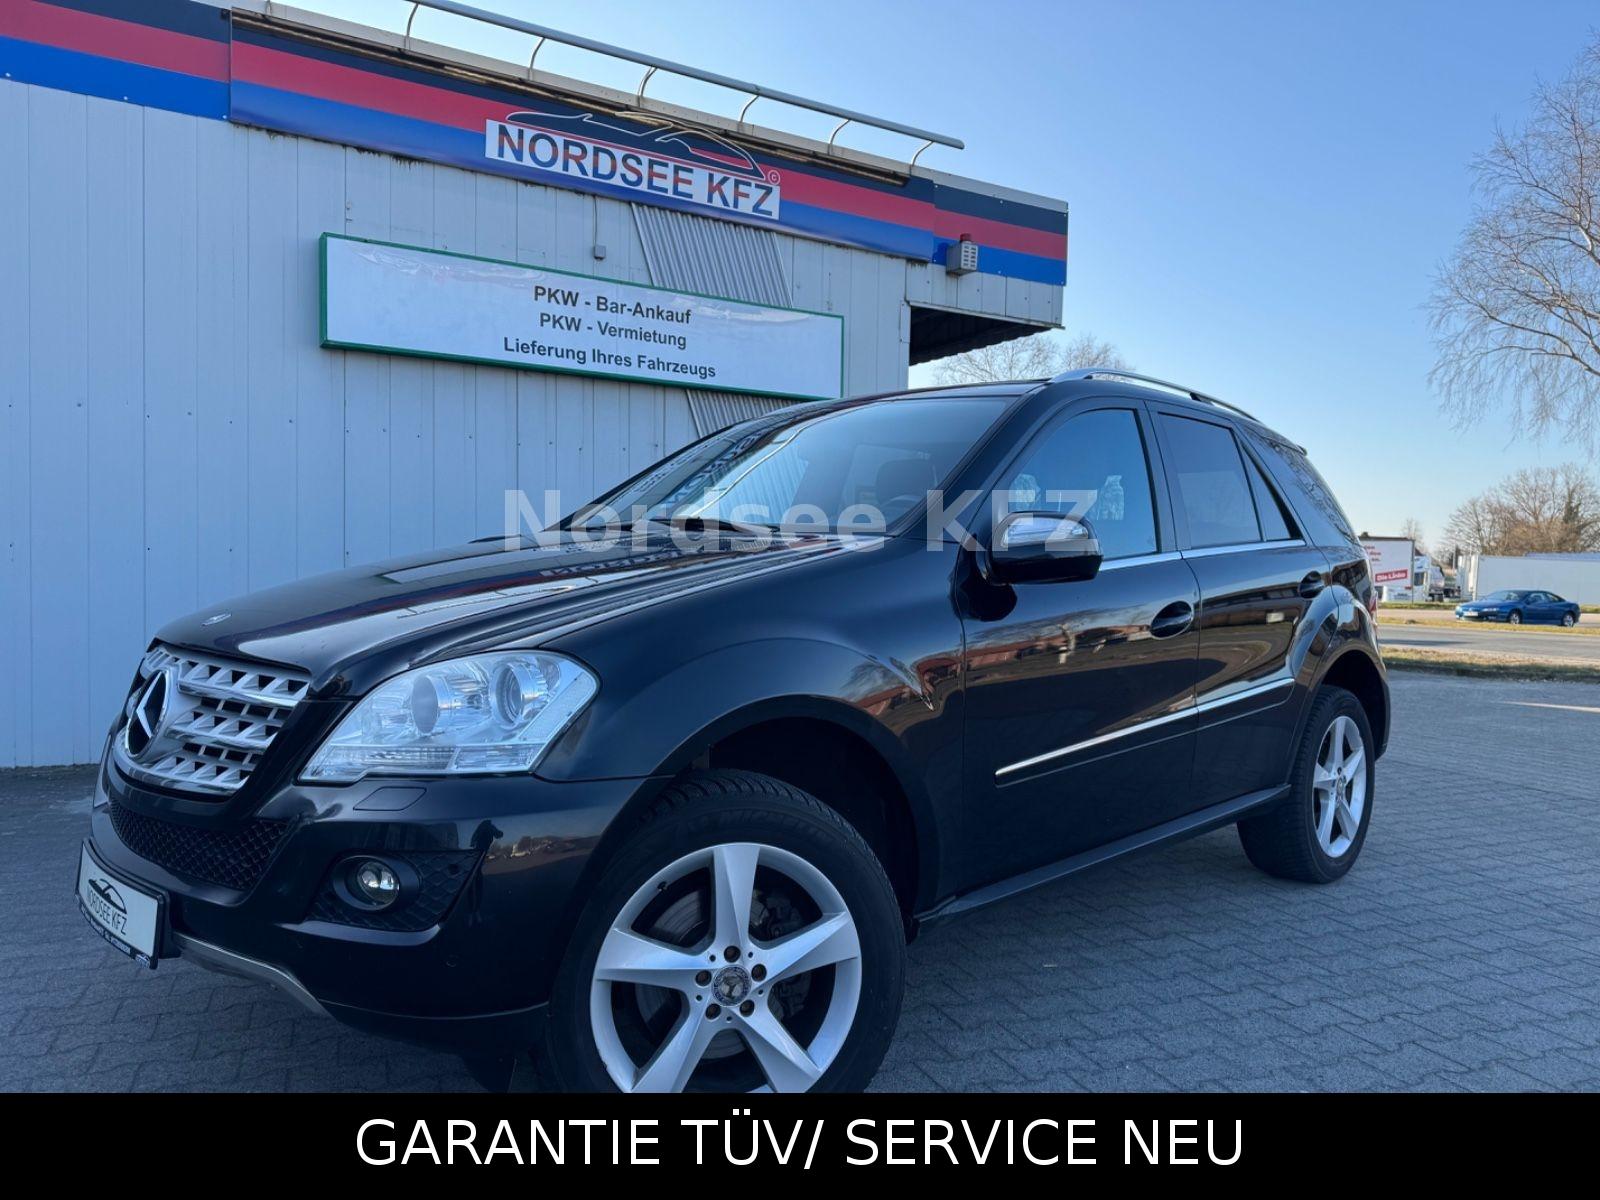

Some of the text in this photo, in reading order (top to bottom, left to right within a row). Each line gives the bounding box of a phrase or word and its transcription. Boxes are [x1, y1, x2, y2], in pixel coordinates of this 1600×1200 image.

[497, 123, 773, 217] NORDSEE KFZ
[533, 285, 580, 307] PKW
[596, 295, 692, 324] Bar-Ankauf
[539, 312, 582, 332] PKW
[597, 321, 687, 350] Vermietung
[503, 337, 716, 380] Lieferung Ihres Fahrzeugs
[112, 910, 127, 935] KFZ
